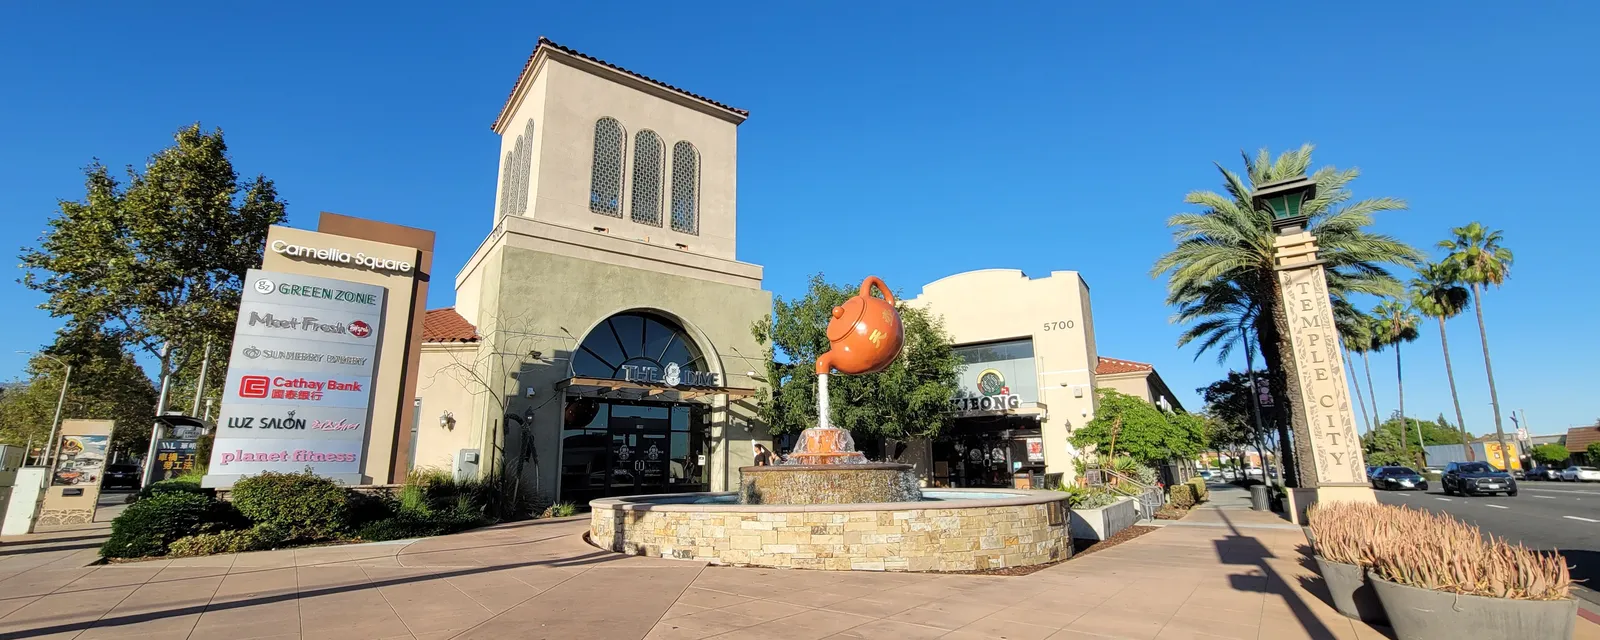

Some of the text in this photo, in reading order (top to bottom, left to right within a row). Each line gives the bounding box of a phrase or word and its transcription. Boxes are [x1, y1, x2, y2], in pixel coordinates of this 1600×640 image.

[271, 239, 411, 273] Camellia Square
[278, 282, 377, 306] GREEN ZONE
[248, 311, 300, 330] Meet
[301, 316, 347, 335] Fresh
[1043, 320, 1074, 332] 5700
[273, 376, 362, 392] Cathay Bank
[621, 364, 720, 387] THE DIVE
[1296, 281, 1345, 466] TEMPLE CITY
[227, 415, 307, 431] LUZ SALON
[220, 449, 357, 465] planet fitness
